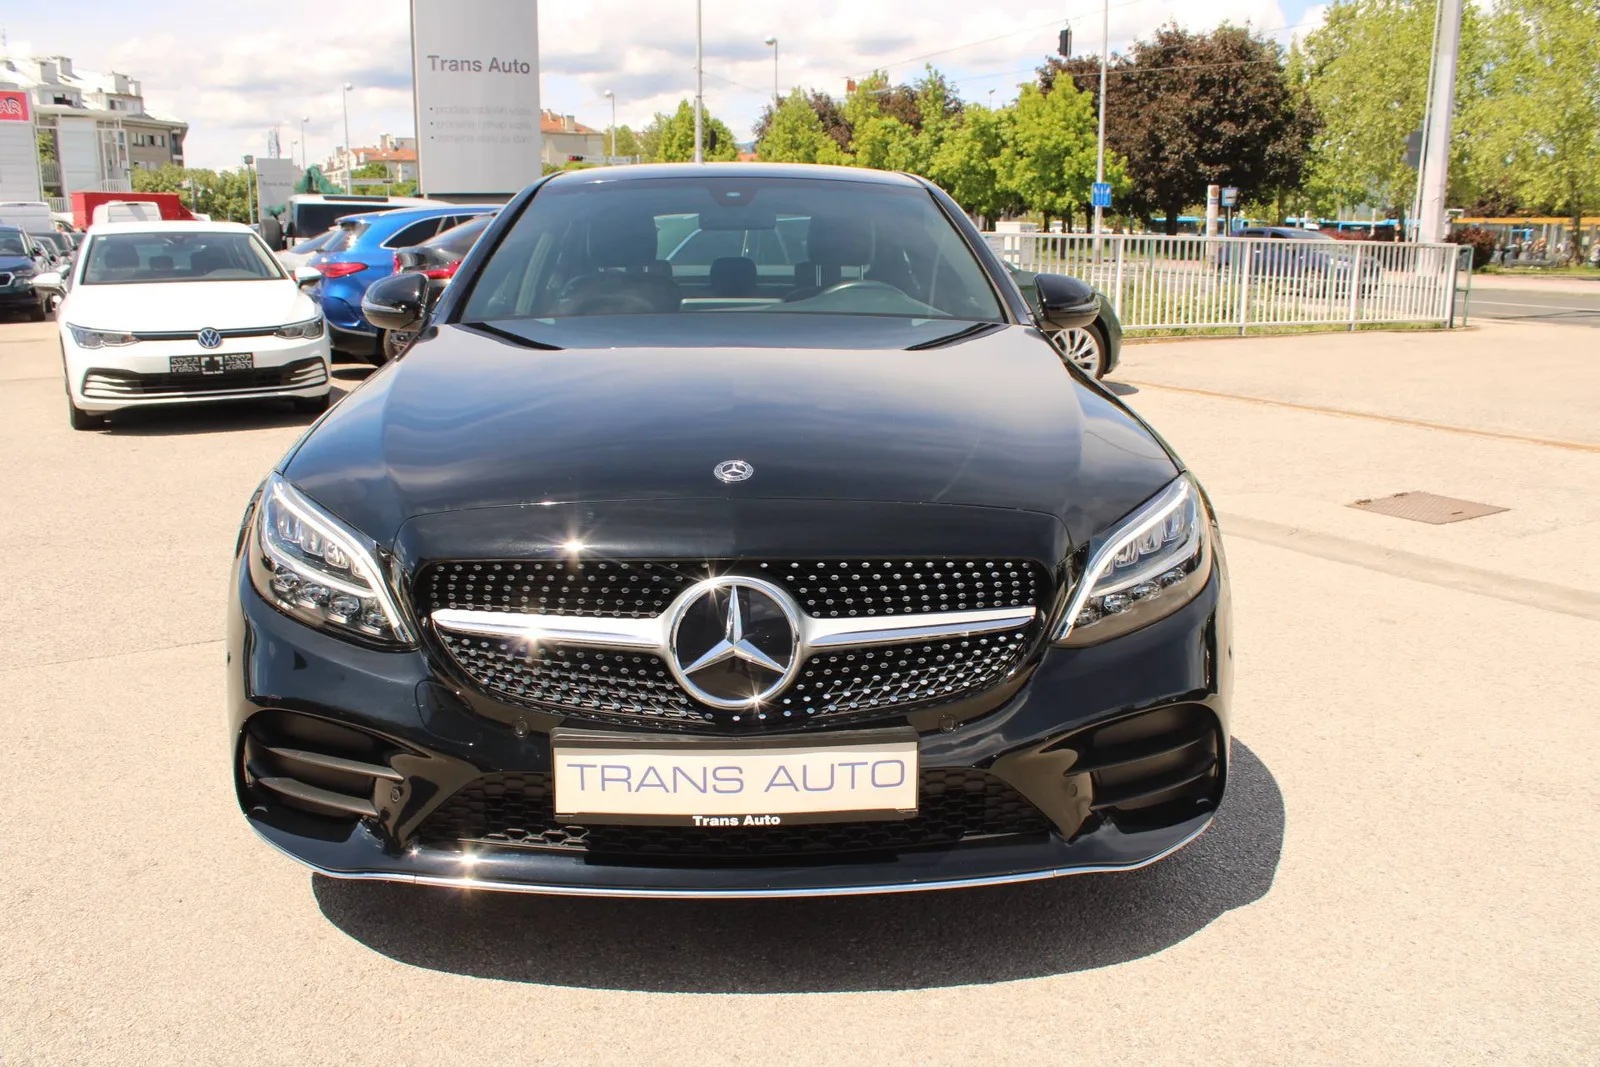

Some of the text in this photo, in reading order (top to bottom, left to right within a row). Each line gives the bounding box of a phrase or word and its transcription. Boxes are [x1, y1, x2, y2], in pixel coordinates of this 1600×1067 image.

[427, 55, 531, 74] Trans Auto
[567, 759, 905, 794] TRANS AUTO
[692, 815, 781, 826] Trans Auto
